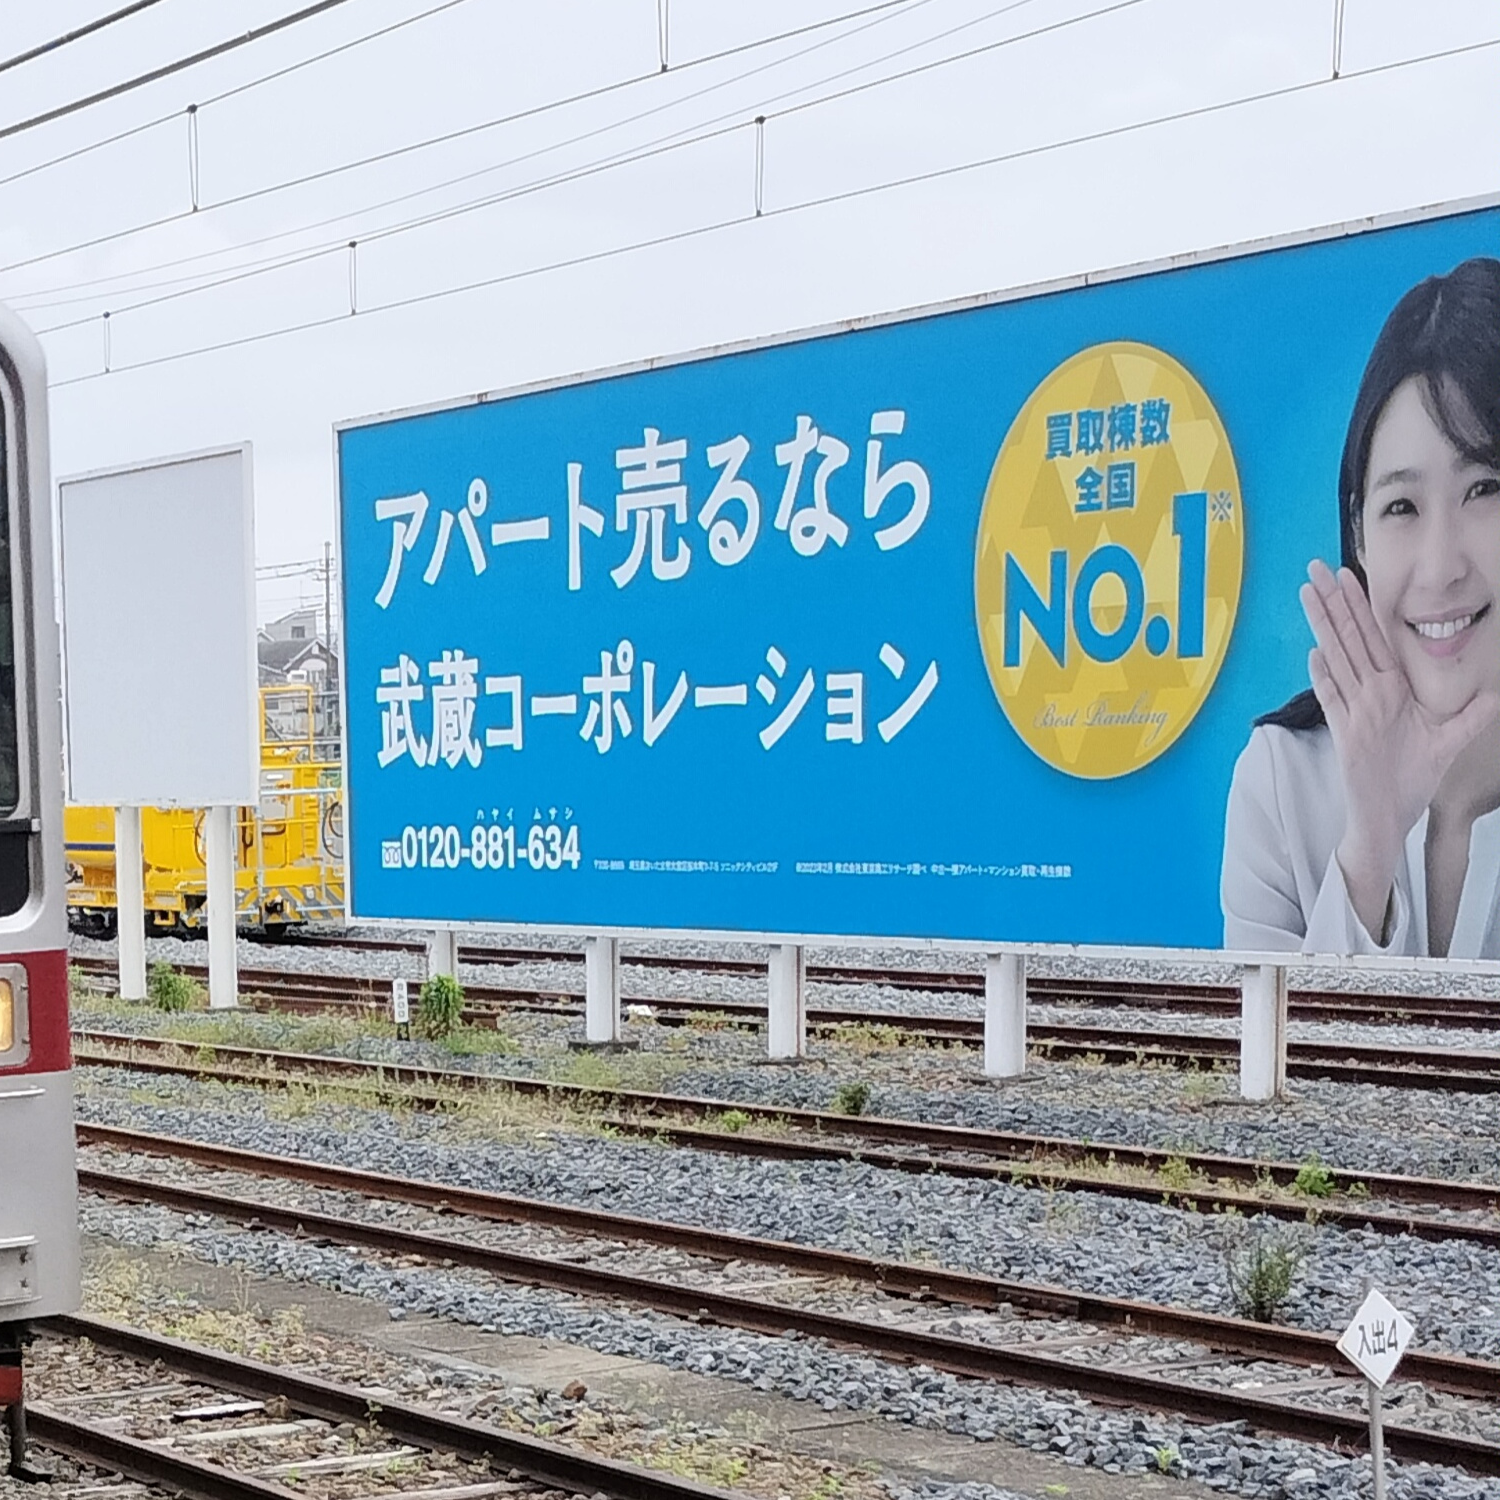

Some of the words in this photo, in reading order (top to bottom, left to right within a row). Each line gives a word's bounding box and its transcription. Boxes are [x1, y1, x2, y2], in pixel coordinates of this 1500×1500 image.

[1045, 398, 1171, 461] 買取棟数
[374, 410, 931, 609] アパート売るなら
[1074, 463, 1136, 513] 全国
[1003, 491, 1209, 669] NO.1
[376, 639, 939, 769] 武蔵コーポレーション
[1033, 702, 1079, 729] Best
[1084, 690, 1168, 748] Ranking
[476, 807, 514, 821] ハヤイ
[533, 807, 574, 821] ムサシ
[402, 825, 581, 870] 0120-881-634
[1358, 1319, 1398, 1359] 入出4
